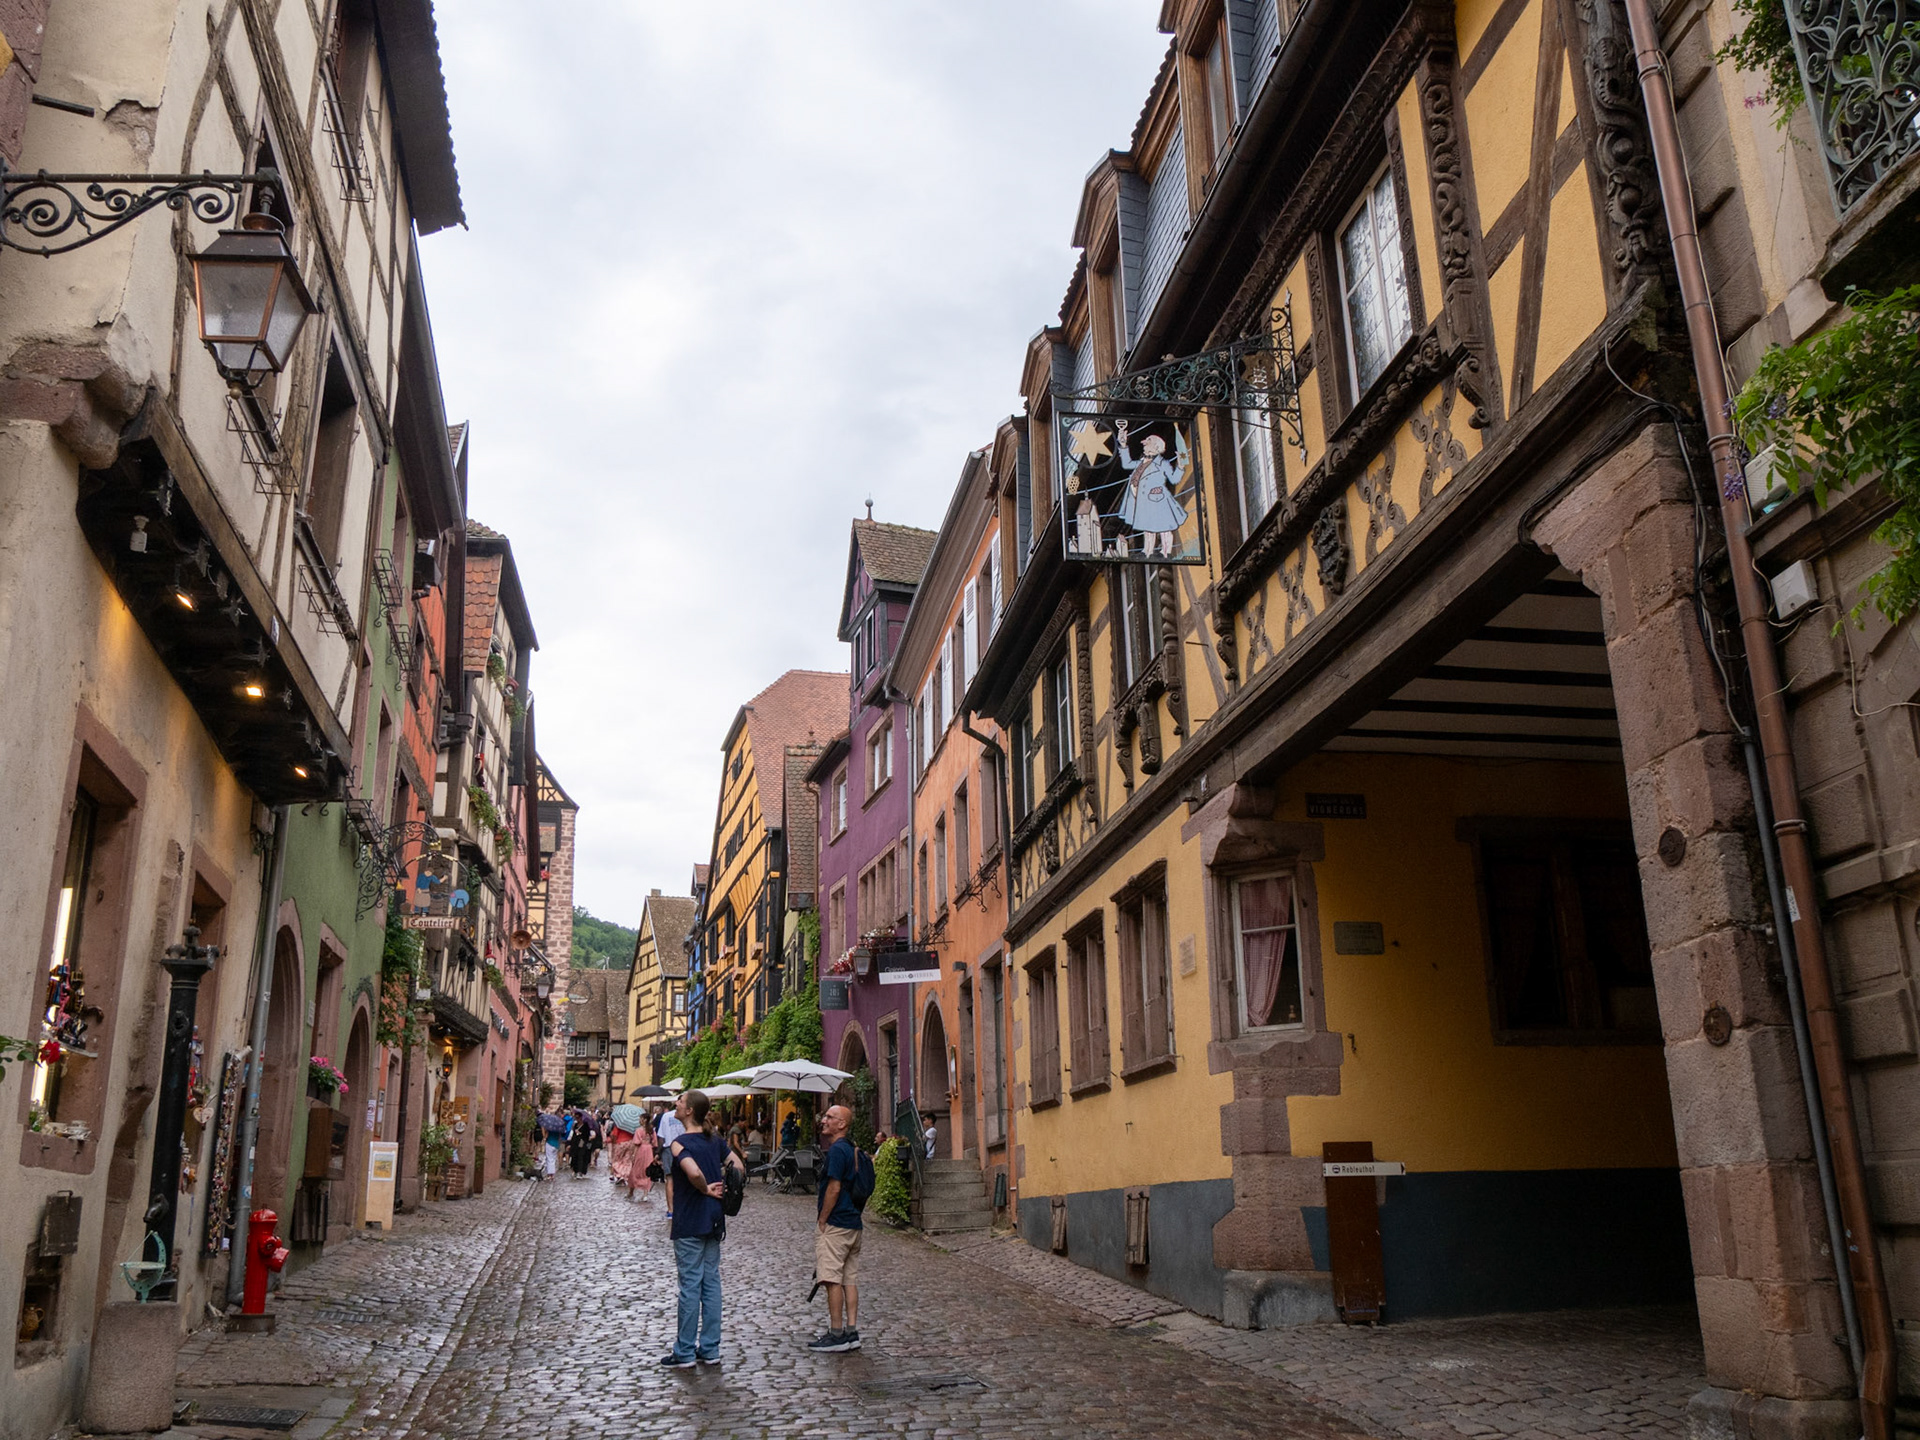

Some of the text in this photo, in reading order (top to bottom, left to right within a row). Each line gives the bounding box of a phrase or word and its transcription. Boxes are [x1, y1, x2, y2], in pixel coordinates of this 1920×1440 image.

[1309, 805, 1364, 815] VIGNERONS
[410, 918, 453, 927] Coutelier
[1342, 1165, 1375, 1173] Rebleuthof
